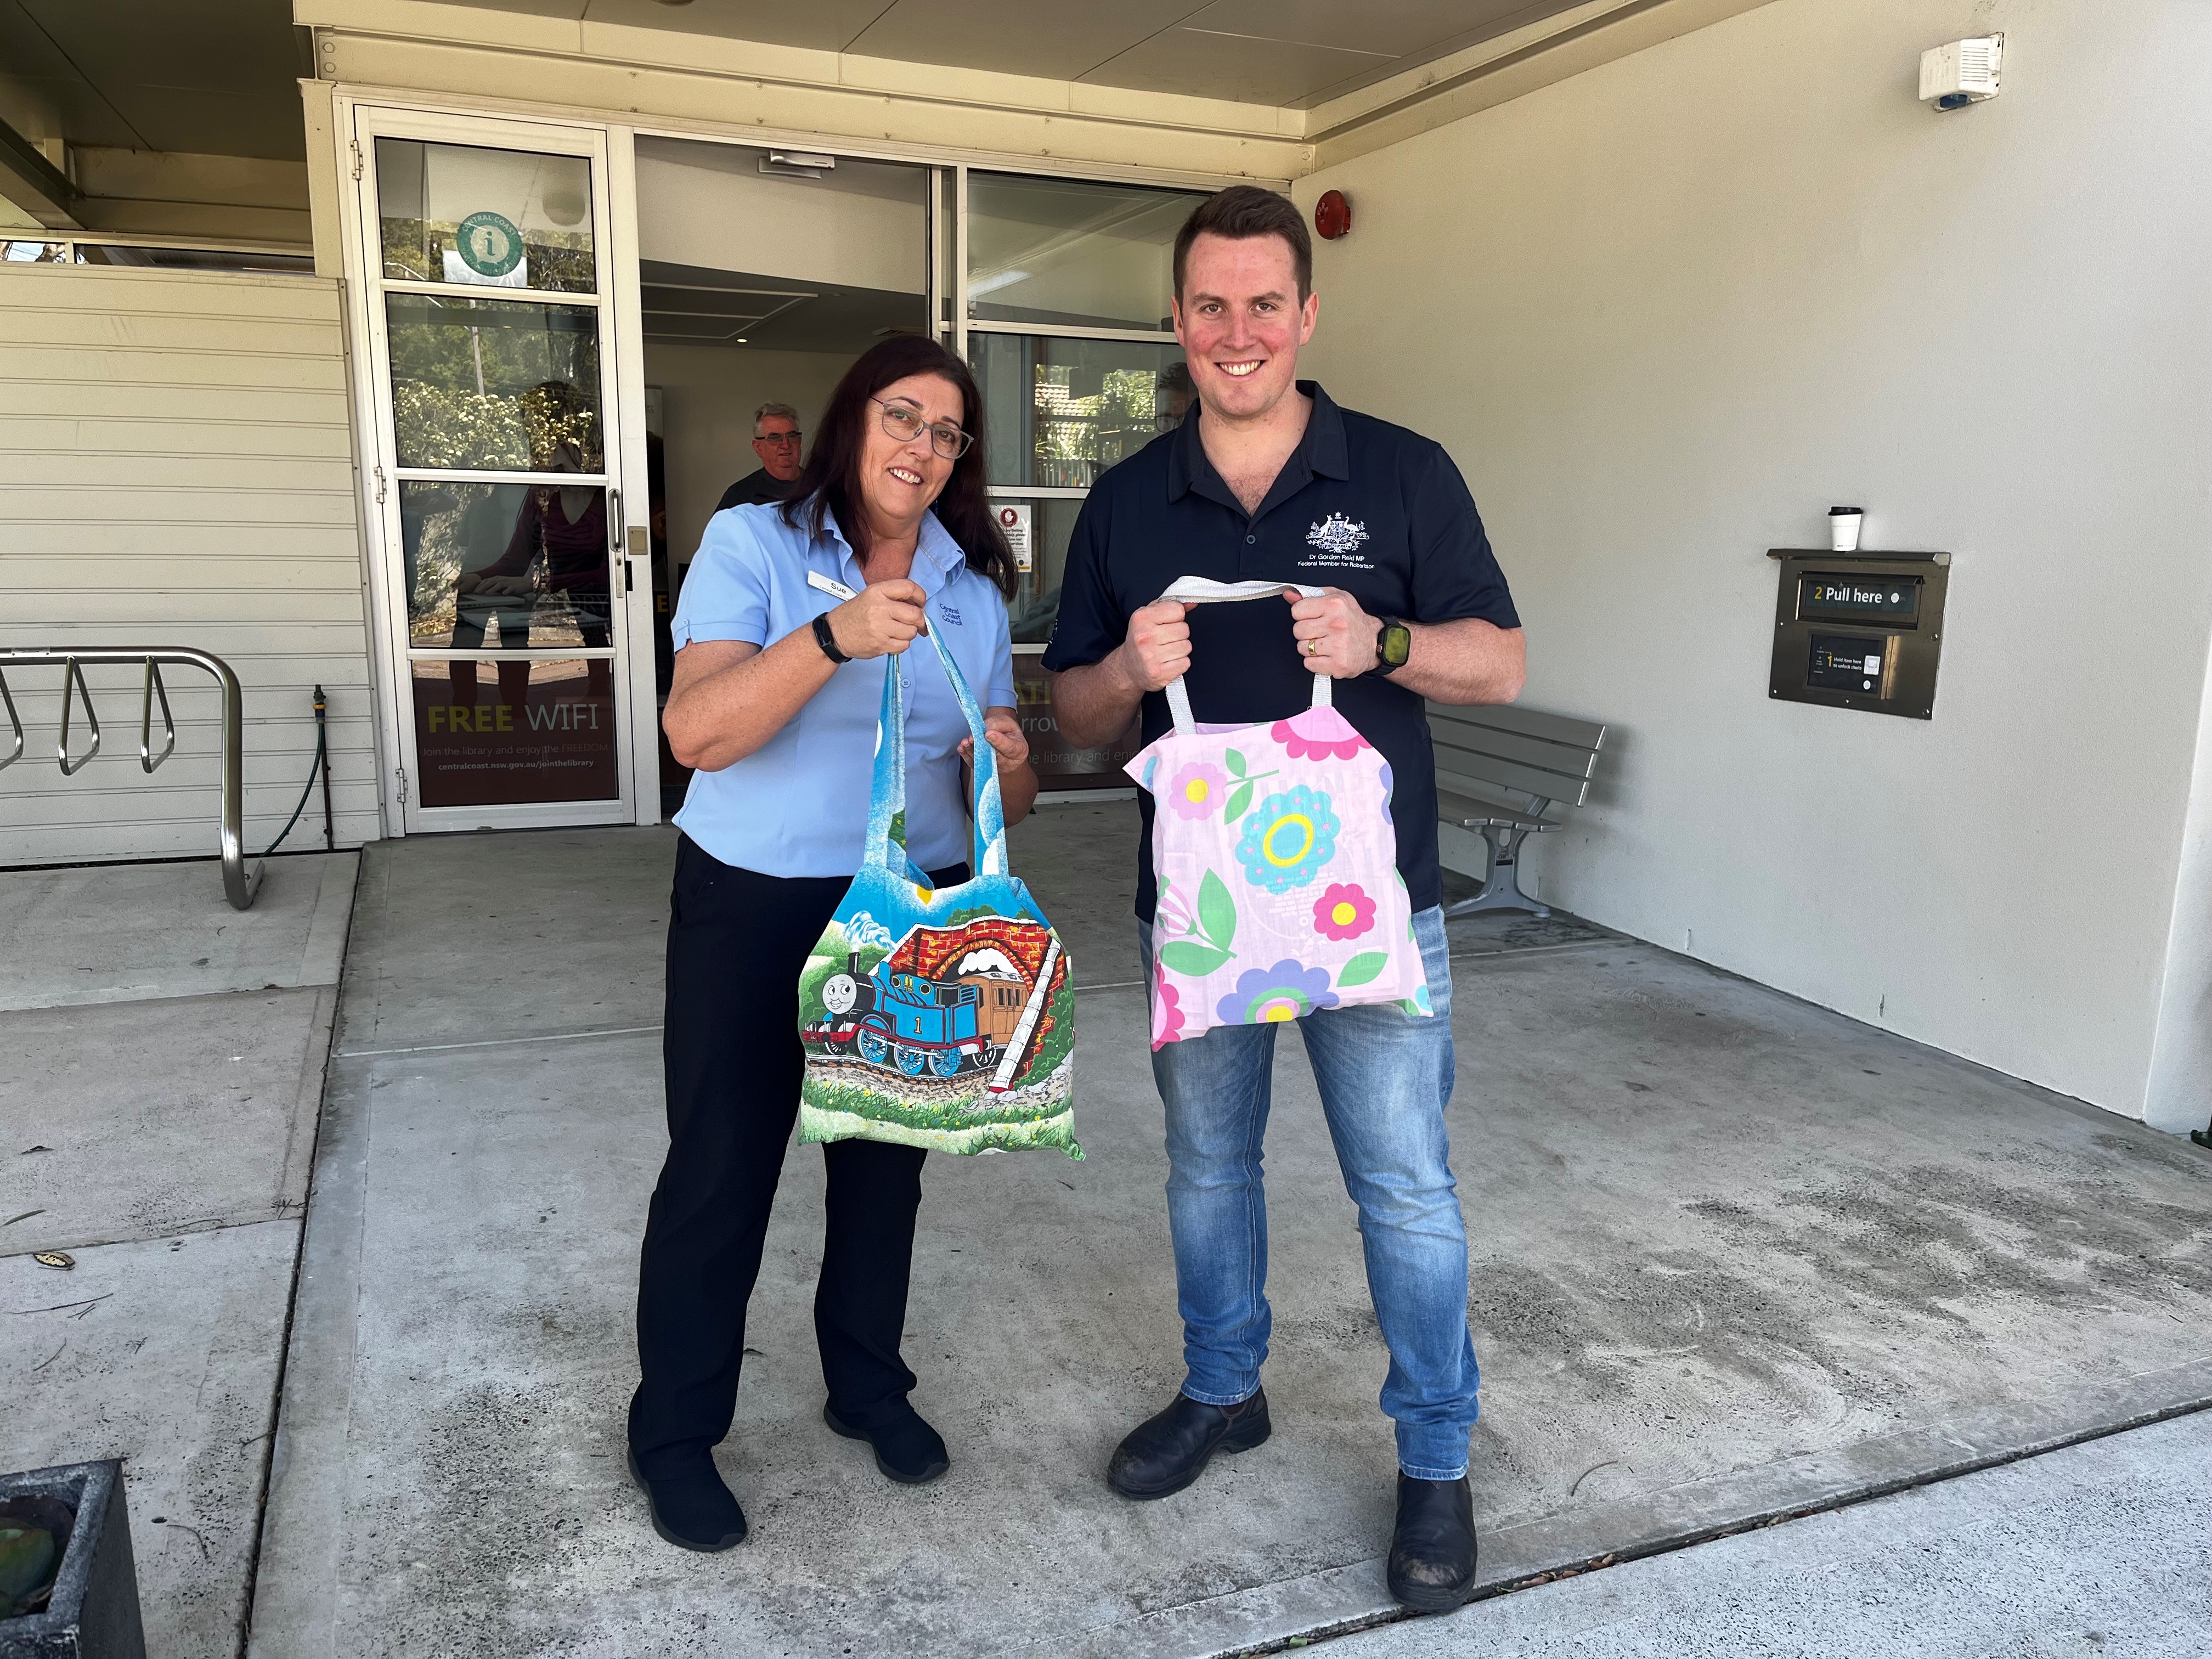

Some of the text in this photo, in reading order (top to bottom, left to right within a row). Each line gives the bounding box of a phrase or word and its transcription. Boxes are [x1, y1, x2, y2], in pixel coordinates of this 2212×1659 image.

[462, 215, 517, 236] CENTRAL COAST
[831, 583, 846, 594] Sue
[1814, 586, 1882, 603] 2 Pull here
[939, 603, 960, 614] Central
[945, 610, 961, 620] Coast
[942, 615, 962, 626] Council
[428, 703, 599, 733] FREE WIFI
[422, 743, 608, 757] Join the library and enjoy the FREEDOM
[1044, 750, 1083, 766] library
[1087, 748, 1110, 762] and
[438, 759, 594, 770] centralcoast.nsw.gov.au/jointhelibrary
[913, 1016, 922, 1034] 1
